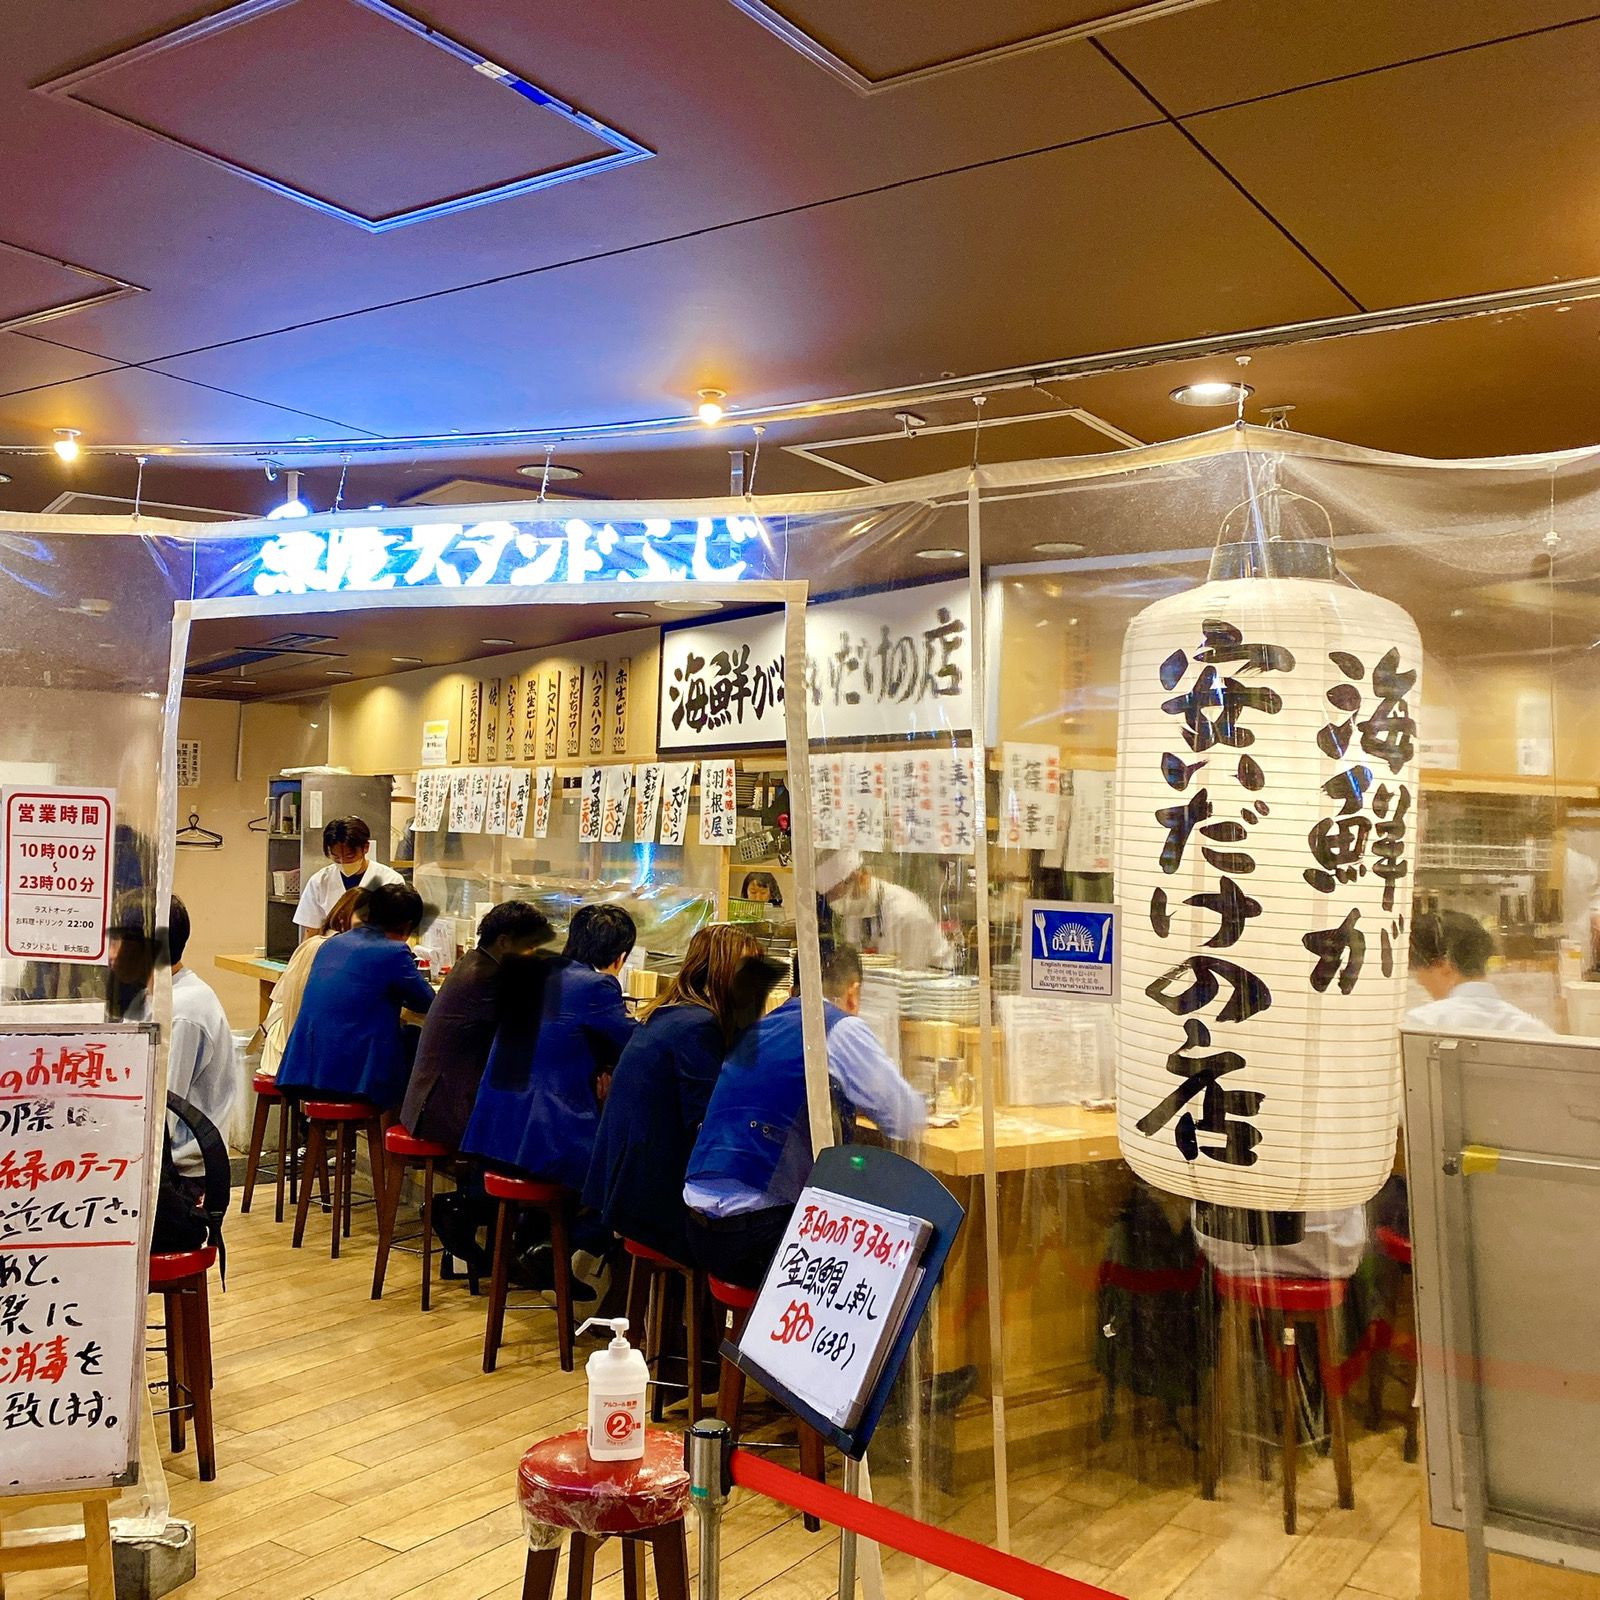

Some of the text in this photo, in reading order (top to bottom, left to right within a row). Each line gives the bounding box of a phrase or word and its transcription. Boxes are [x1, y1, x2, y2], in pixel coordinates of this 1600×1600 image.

[670, 607, 966, 733] 海鮮がいだけの店
[525, 680, 537, 740] 黒生ビール
[545, 678, 557, 740] トマトハイ
[615, 668, 628, 735] 赤生ビール
[17, 803, 100, 826] 営業時間
[711, 768, 725, 838] 羽根屋
[1302, 647, 1418, 995] 海鮮が
[20, 842, 97, 862] 10時00分
[18, 874, 96, 894] 23時00分
[1136, 619, 1296, 1167] 安いだけの店
[34, 905, 80, 914] ラストオーダー
[67, 920, 94, 929] 22:00
[1052, 929, 1094, 953] OSAKA
[3, 1391, 118, 1429] 致します。
